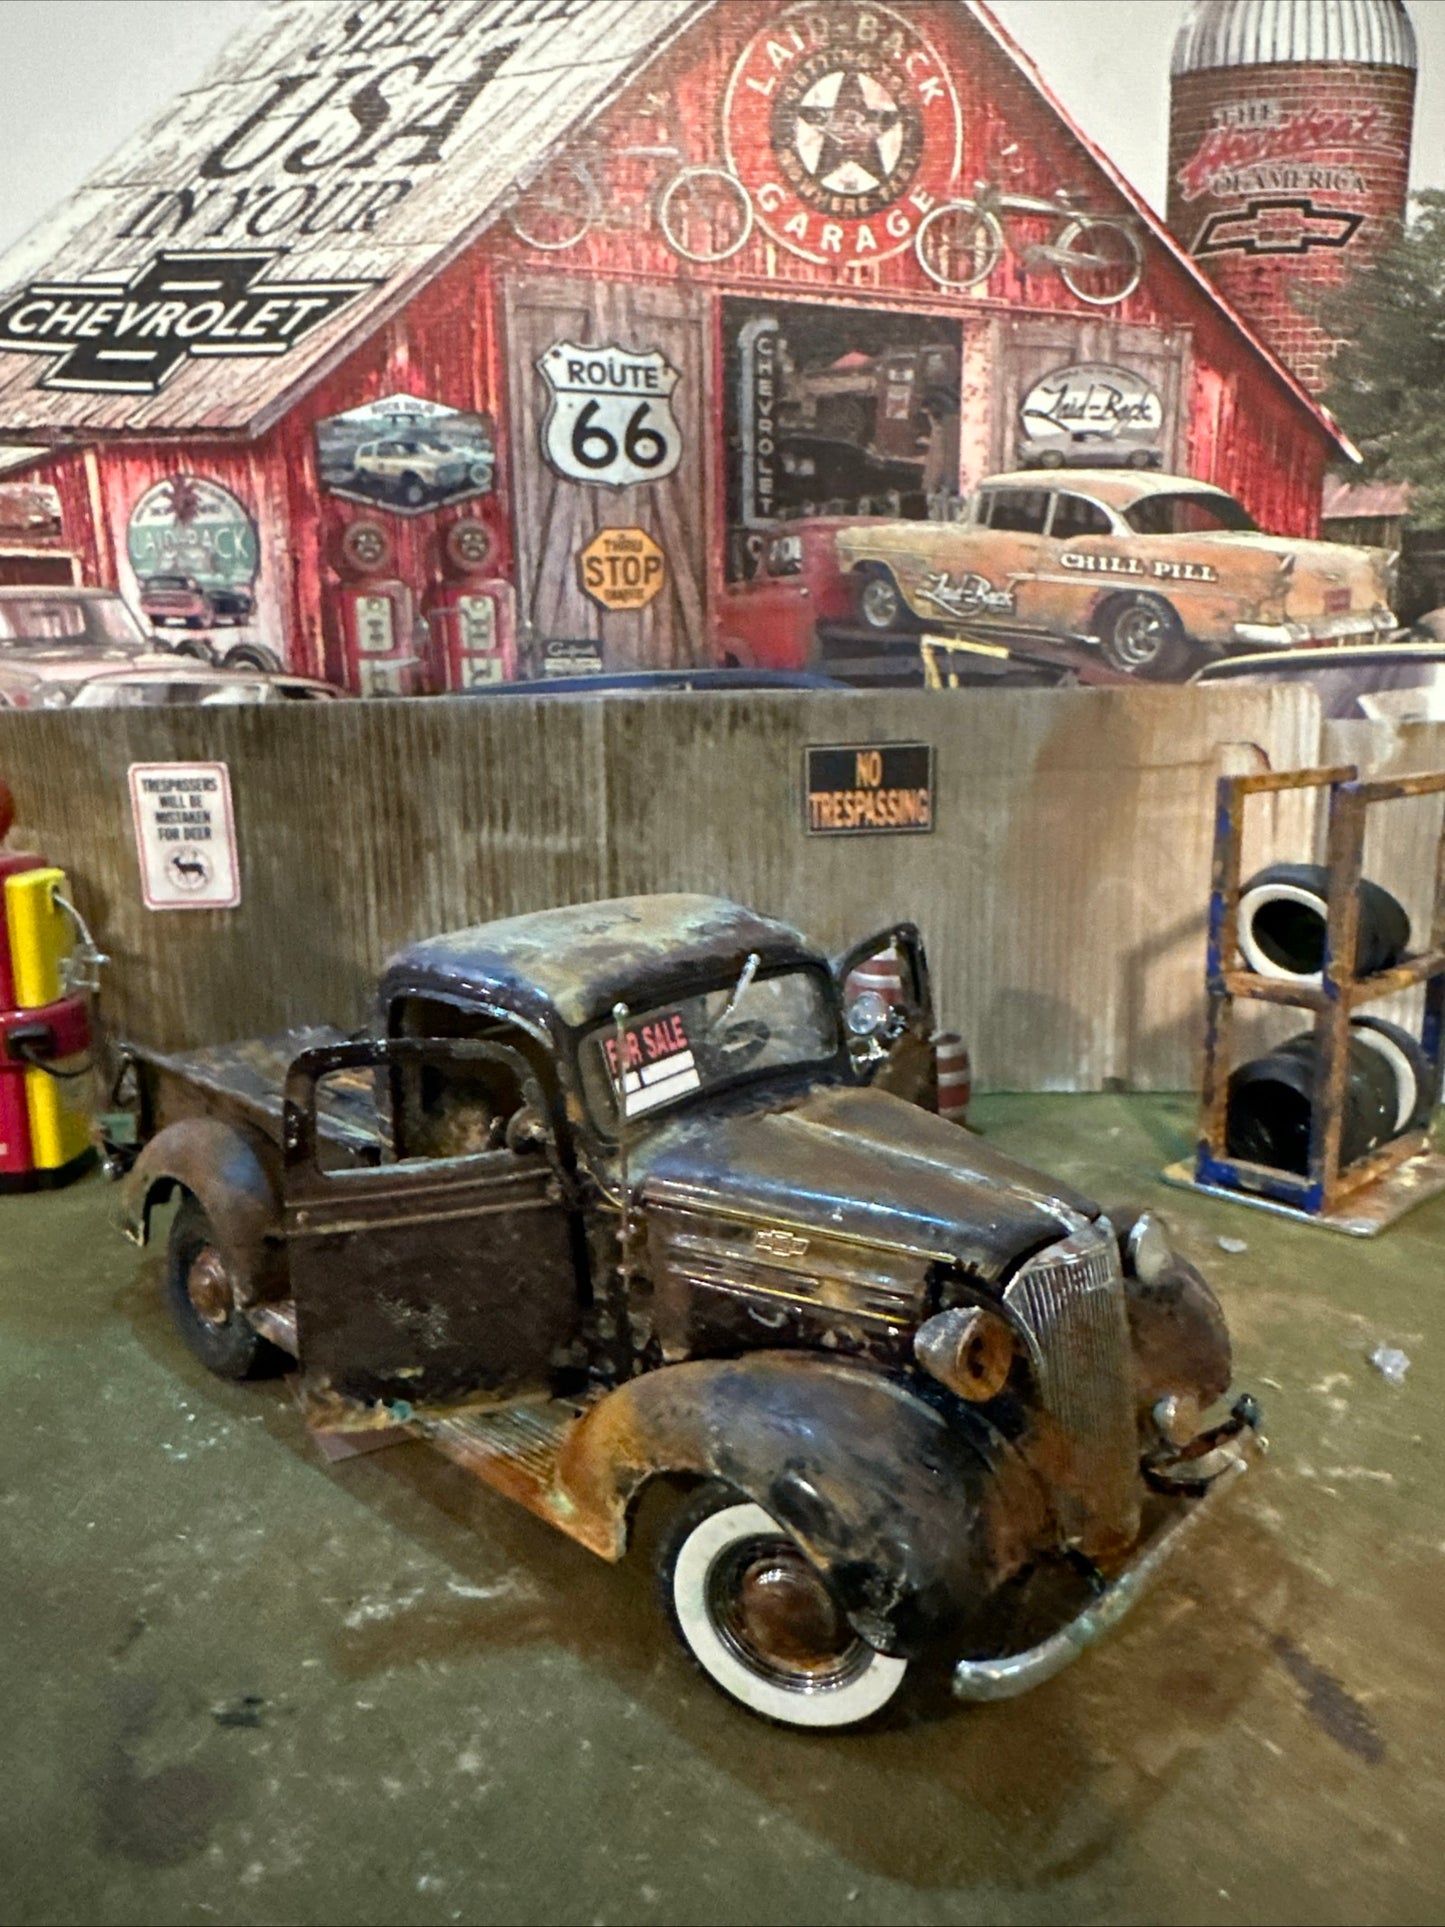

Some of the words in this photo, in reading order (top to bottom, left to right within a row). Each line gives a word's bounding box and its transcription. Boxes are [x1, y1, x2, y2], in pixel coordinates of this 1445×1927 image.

[199, 39, 521, 179] USA
[1214, 102, 1275, 128] THE
[1251, 168, 1369, 194] AMERICA
[116, 185, 222, 239] IN
[204, 179, 415, 238] YOUR
[757, 183, 936, 253] GARAGE
[7, 299, 330, 338] CHEVROLET
[567, 359, 659, 389] ROUTE
[571, 398, 668, 469] 66
[757, 336, 775, 514] CHEVROLET
[585, 555, 661, 588] STOP
[1061, 553, 1144, 574] CHILL
[1153, 561, 1217, 582] PILL
[141, 778, 218, 792] TRESPASSERS
[856, 750, 882, 787] NO
[809, 789, 928, 829] TRESPASSING
[642, 1014, 688, 1058] SALE
